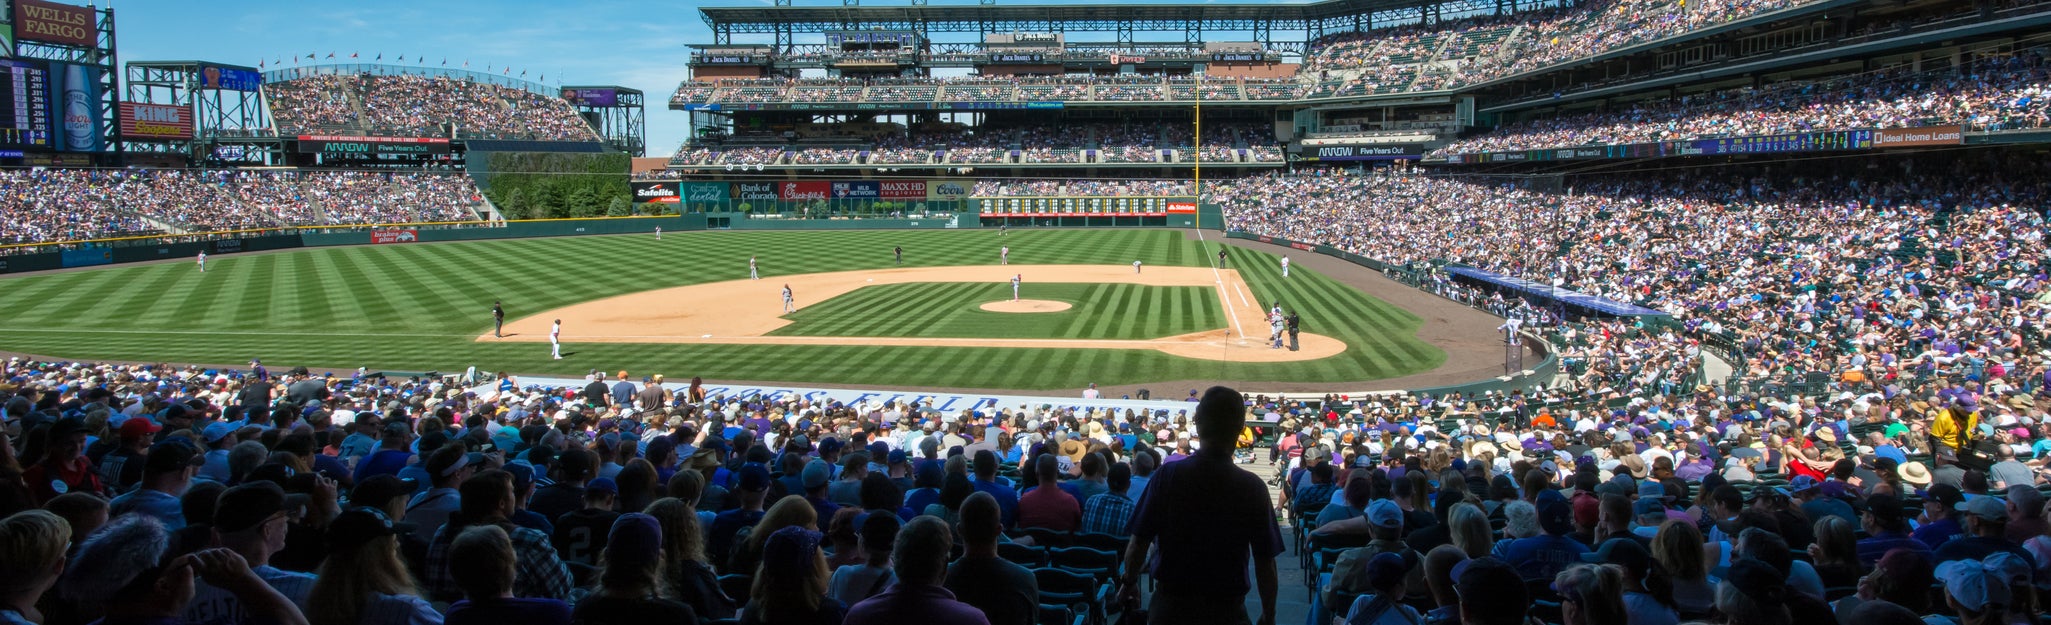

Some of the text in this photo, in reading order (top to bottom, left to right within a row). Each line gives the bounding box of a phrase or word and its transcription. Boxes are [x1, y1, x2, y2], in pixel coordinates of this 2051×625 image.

[22, 4, 86, 26] WELLS
[25, 19, 86, 40] FARGO
[133, 106, 180, 122] KING
[134, 121, 180, 137] Soopers
[1905, 133, 1930, 142] Home
[1932, 132, 1960, 140] Loans
[325, 143, 369, 152] ARROW
[1319, 147, 1353, 156] ARROW
[1392, 146, 1404, 154] Out
[741, 183, 771, 192] Bank of
[881, 183, 926, 191] MAXX HD
[936, 183, 965, 195] Coors
[638, 188, 674, 197] Safelite
[689, 190, 722, 200] dental
[741, 192, 778, 200] Colorado
[568, 526, 592, 563] 2
